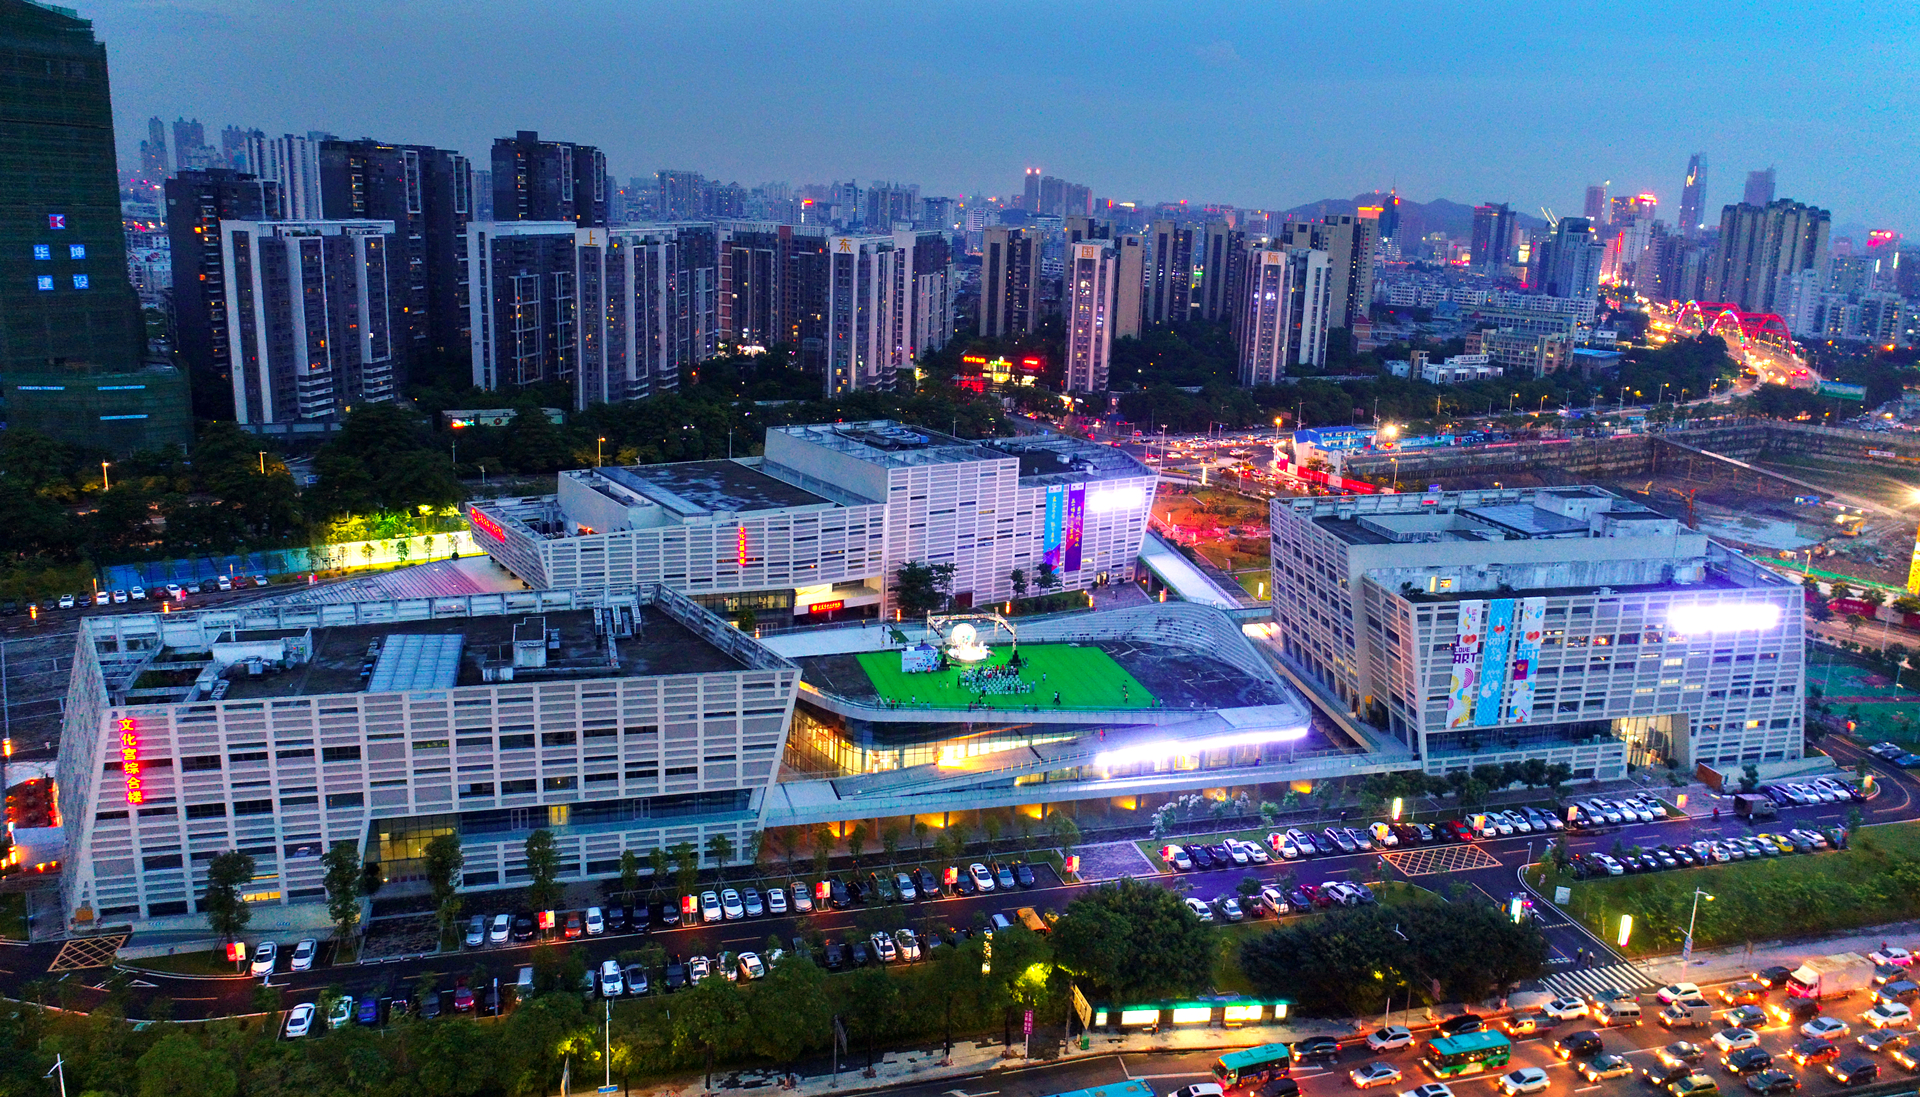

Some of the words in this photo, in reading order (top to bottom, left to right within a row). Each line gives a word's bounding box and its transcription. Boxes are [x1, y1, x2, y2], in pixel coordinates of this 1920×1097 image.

[583, 230, 599, 246] 上
[838, 238, 852, 253] 东
[1081, 246, 1094, 258] 国
[1267, 252, 1279, 264] 际
[1455, 634, 1461, 647] I
[1519, 631, 1526, 644] I
[1453, 652, 1478, 664] ART
[1516, 649, 1540, 660] ART
[118, 718, 143, 803] 文化宫综合楼
